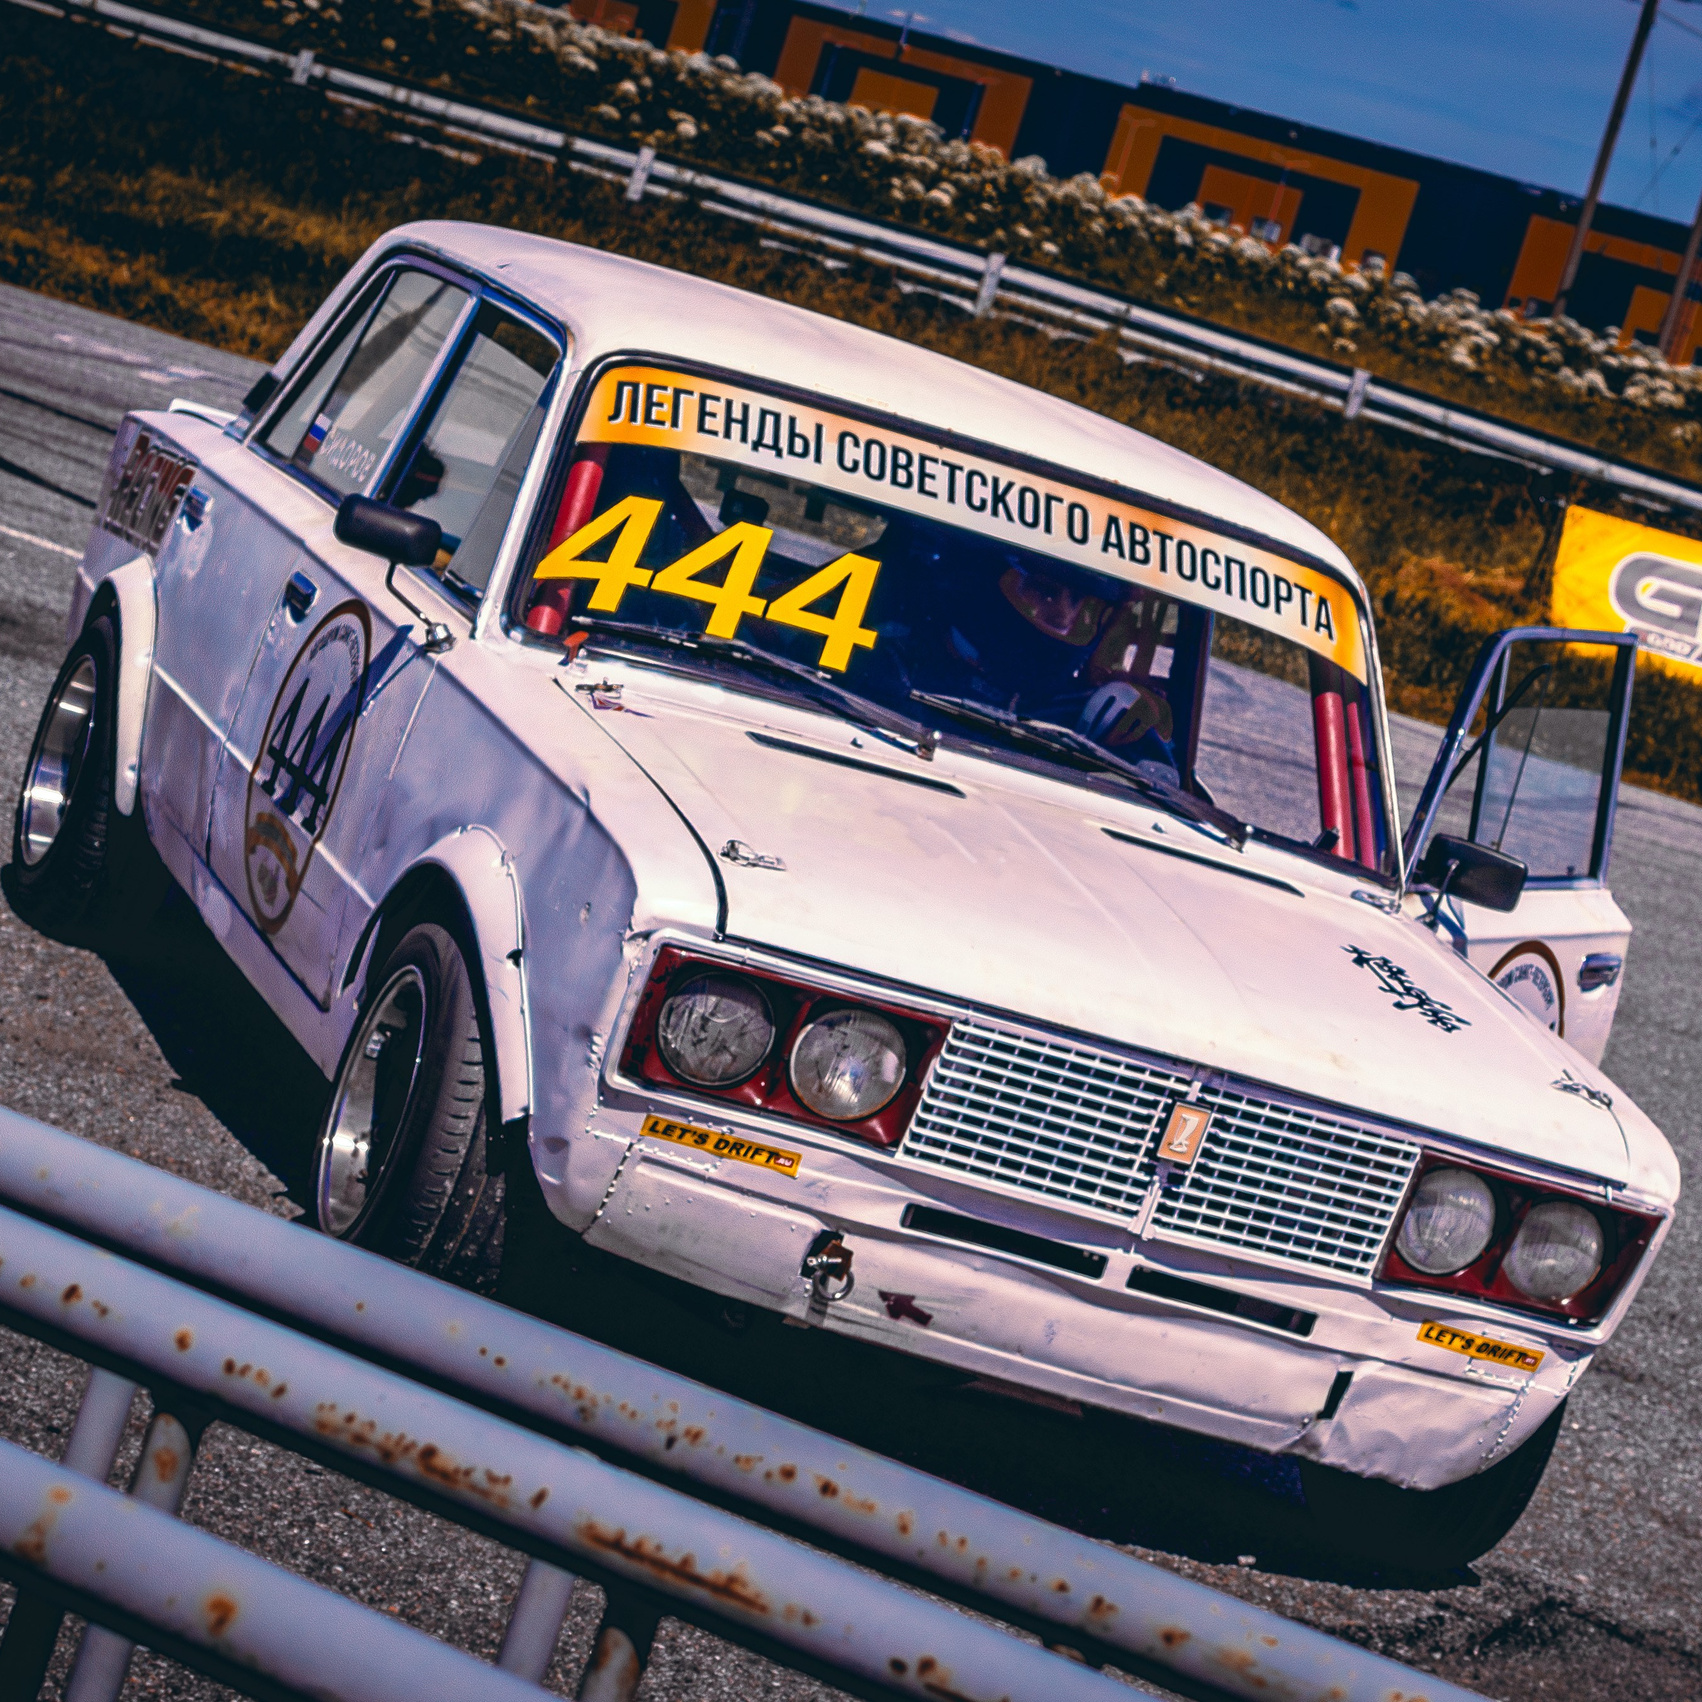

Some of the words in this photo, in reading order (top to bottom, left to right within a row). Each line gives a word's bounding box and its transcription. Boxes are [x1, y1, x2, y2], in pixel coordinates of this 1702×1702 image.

[533, 495, 881, 673] 444
[607, 380, 825, 464] ЛЕГЕНДЫ
[836, 430, 1089, 545] СОВЕТСКОГО
[1101, 514, 1336, 641] АВТОСПОРТА
[261, 677, 352, 836] 444
[649, 1120, 709, 1145] LET'S
[1424, 1326, 1475, 1350] LET'S
